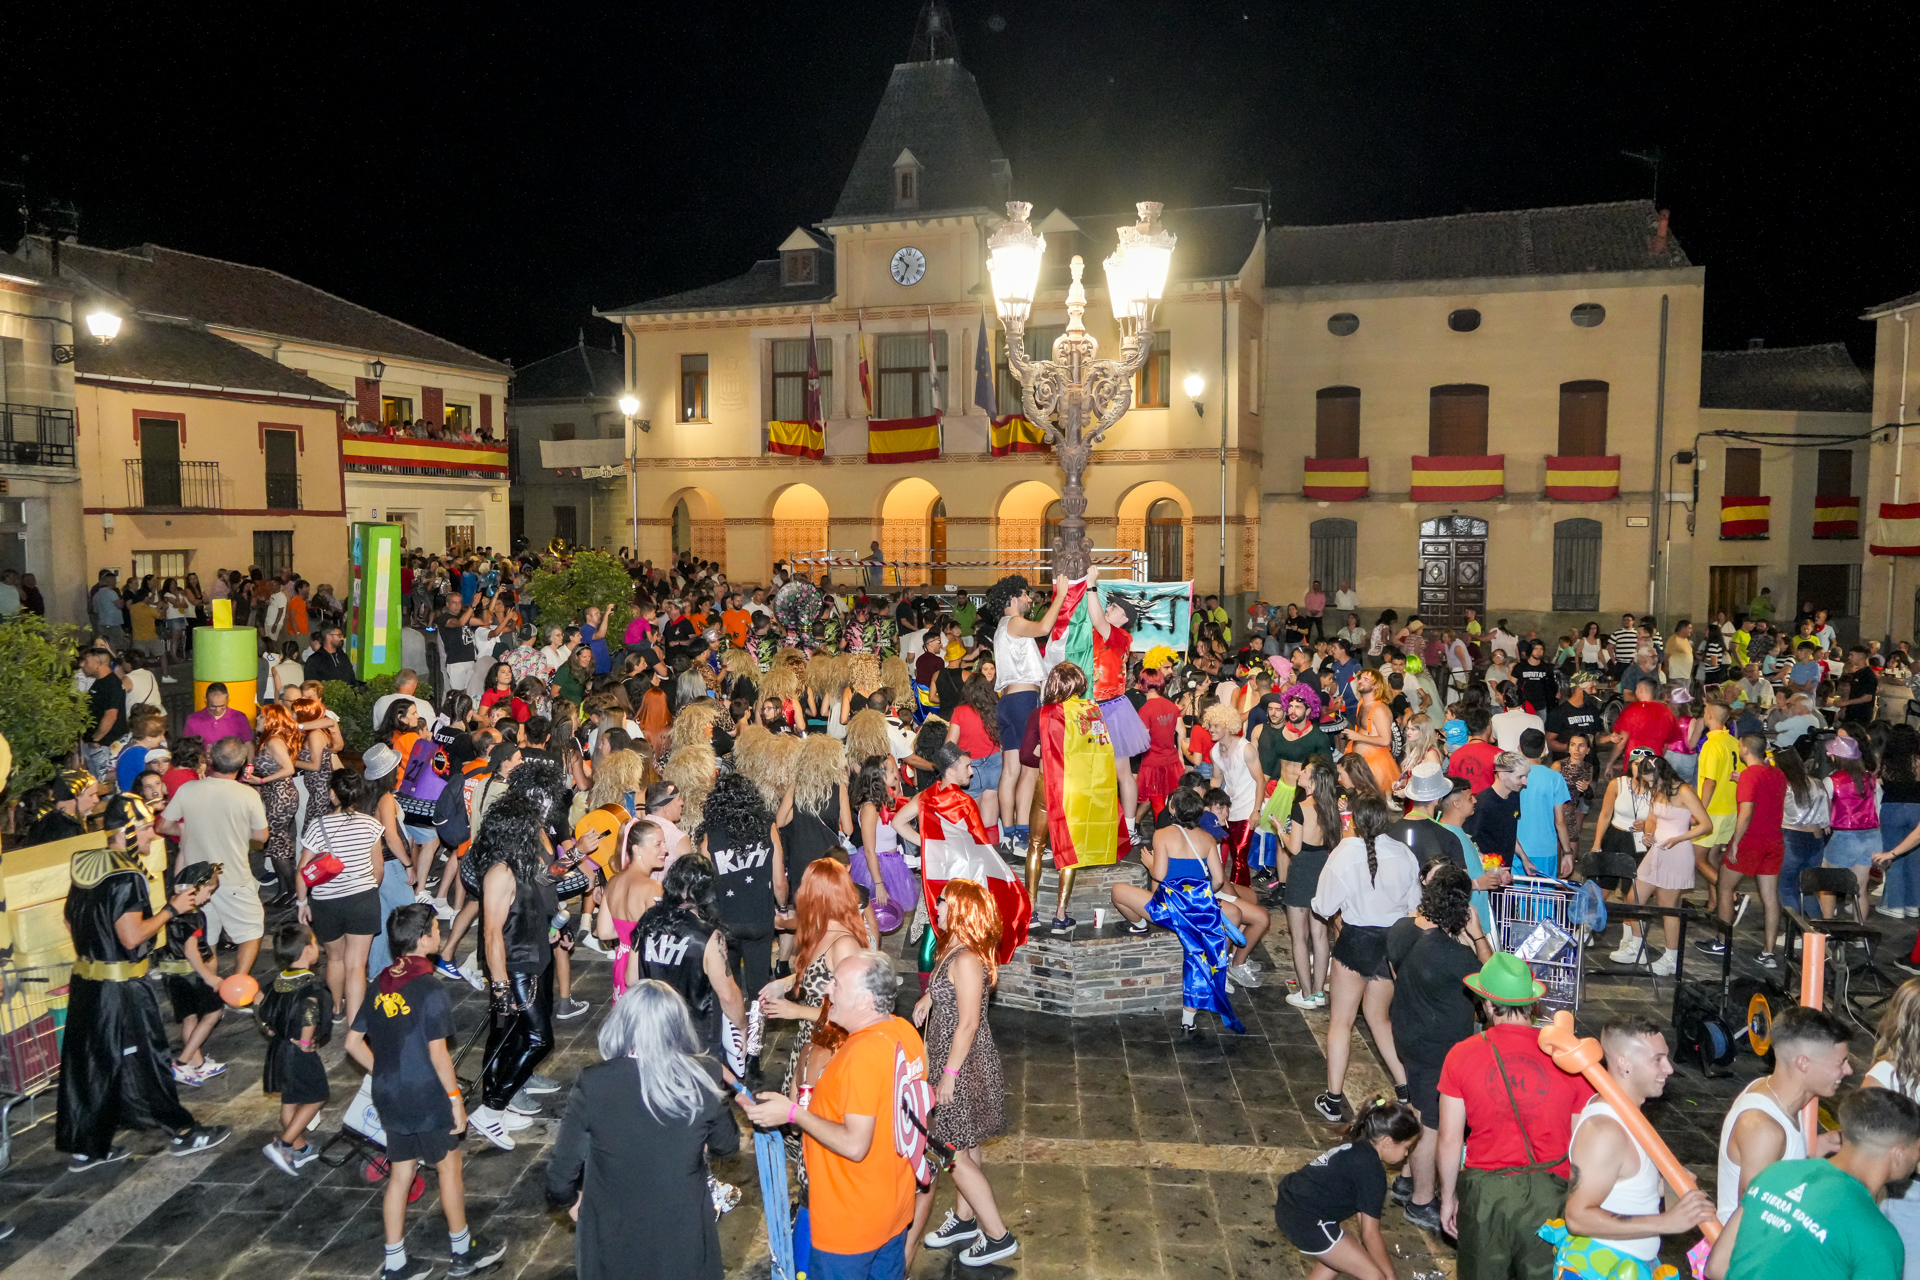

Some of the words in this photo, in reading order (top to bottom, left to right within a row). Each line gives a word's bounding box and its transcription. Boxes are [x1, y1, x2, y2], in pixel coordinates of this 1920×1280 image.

[1747, 1186, 1760, 1198] LA
[1760, 1191, 1793, 1214] SIERRA
[1792, 1208, 1827, 1244] EDUCA
[1760, 1209, 1792, 1234] EQUIPO
